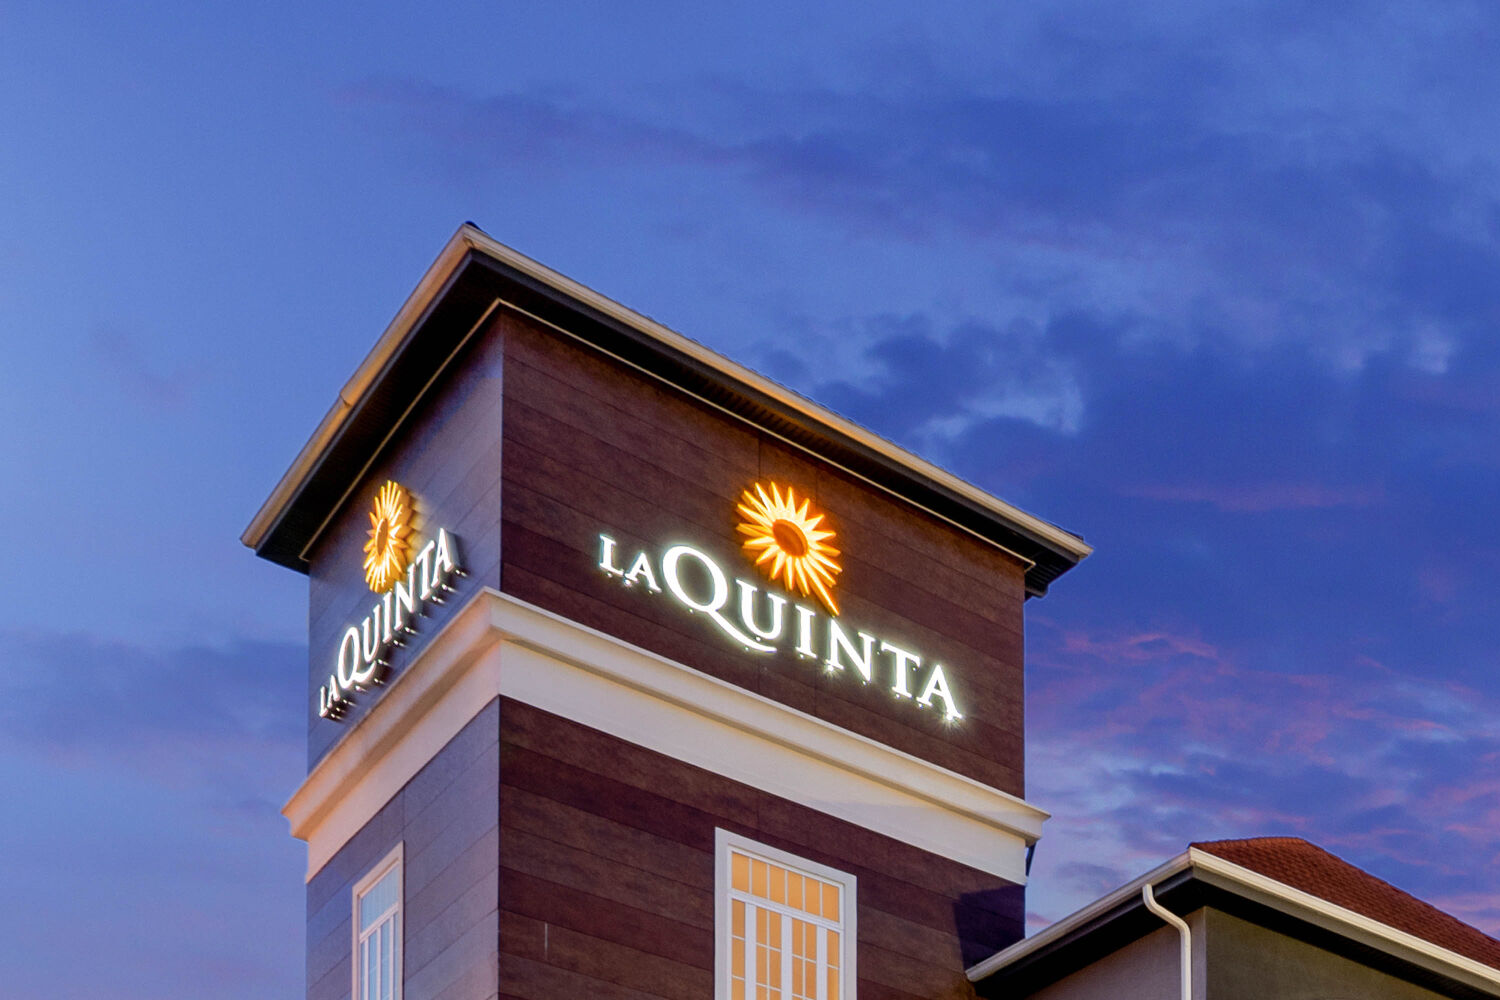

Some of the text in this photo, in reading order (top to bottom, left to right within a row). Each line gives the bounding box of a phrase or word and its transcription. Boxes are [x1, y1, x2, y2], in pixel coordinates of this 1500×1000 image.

[319, 527, 455, 718] LA QUINTA
[599, 534, 964, 721] LA QUINTA
